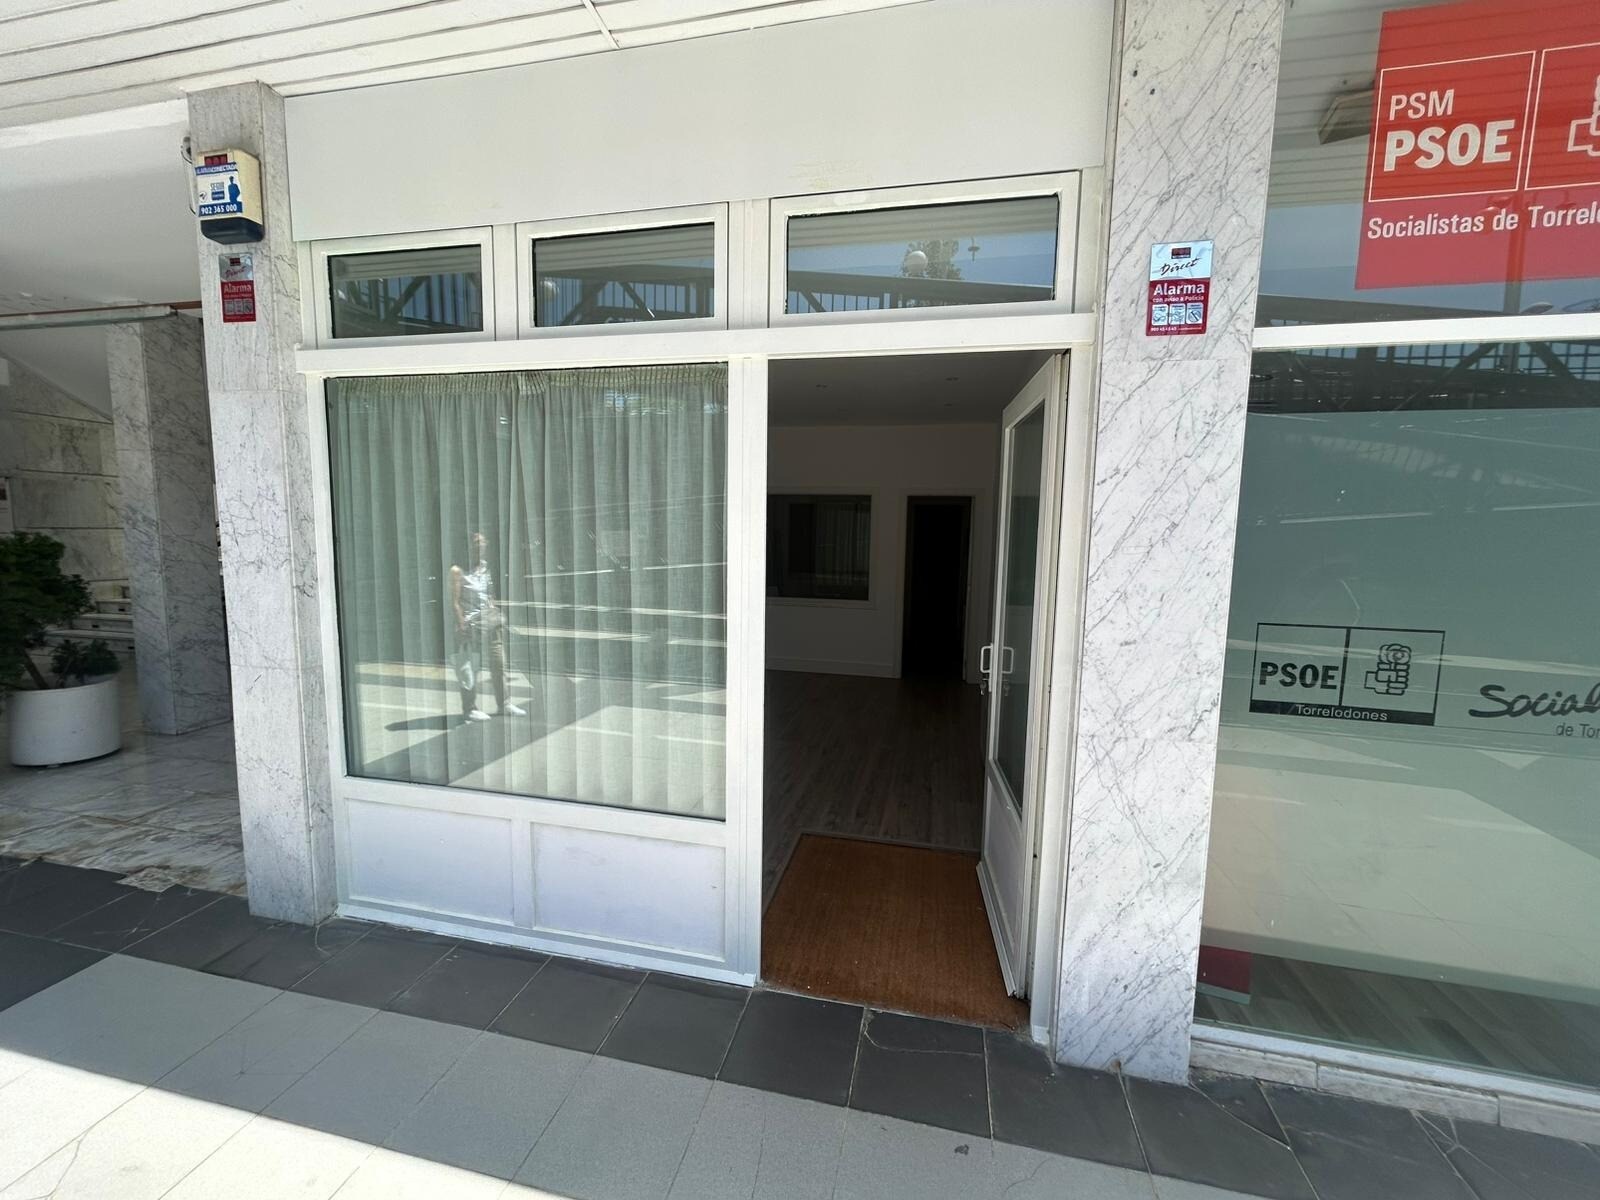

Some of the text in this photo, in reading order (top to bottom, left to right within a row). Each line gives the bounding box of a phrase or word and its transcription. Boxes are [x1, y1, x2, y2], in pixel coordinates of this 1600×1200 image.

[1389, 88, 1456, 121] PSM
[1383, 119, 1516, 172] PSOE
[200, 206, 212, 215] 902
[225, 203, 238, 212] 000
[1367, 212, 1485, 240] Socialistas
[1492, 208, 1519, 231] de
[1160, 257, 1202, 276] Direct
[224, 283, 252, 293] Alarma
[1153, 283, 1205, 296] Alarma
[1258, 661, 1339, 690] PSOE
[1295, 704, 1389, 721] Torrelodones
[1555, 722, 1574, 736] de
